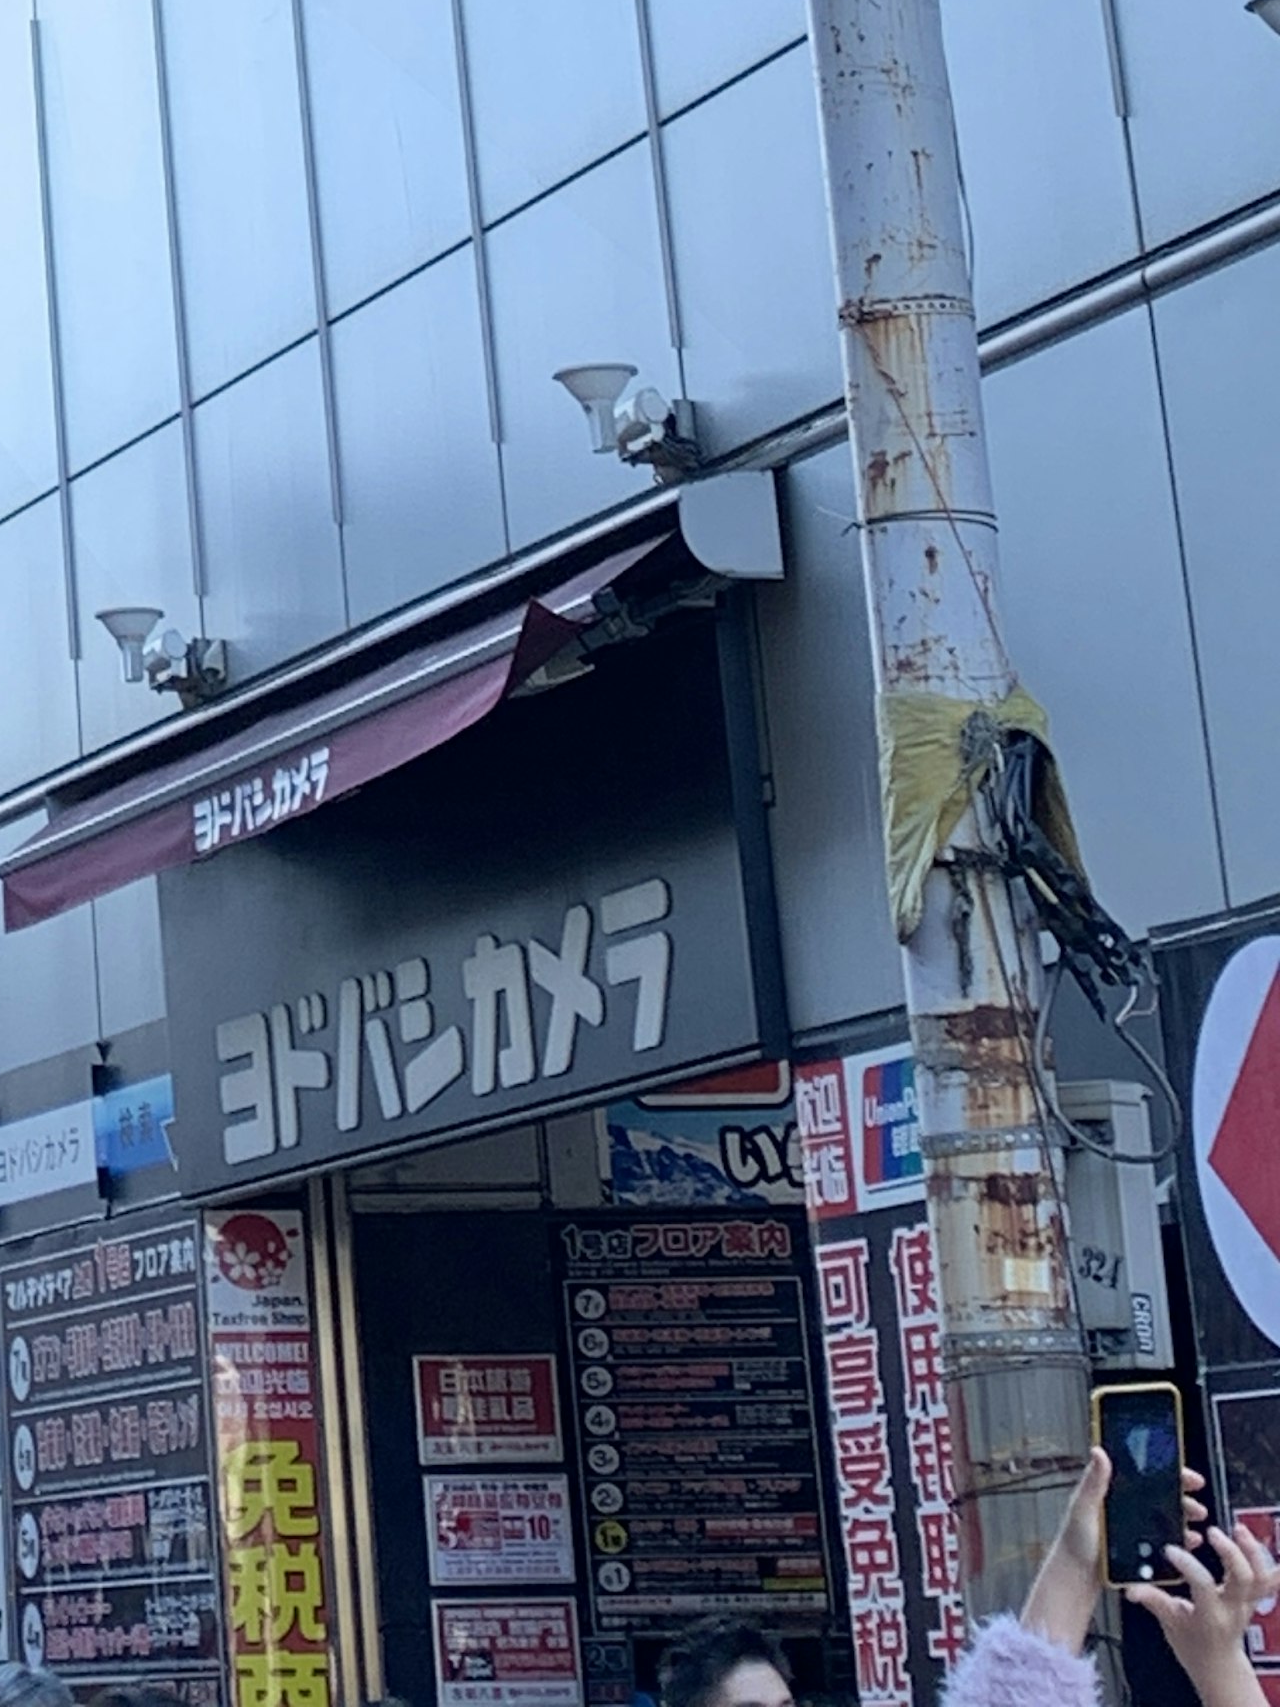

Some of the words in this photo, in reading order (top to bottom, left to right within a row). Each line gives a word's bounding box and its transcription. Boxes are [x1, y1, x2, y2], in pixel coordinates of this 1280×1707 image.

[193, 748, 330, 852] ヨドバシカメラ
[216, 877, 671, 1166] ヨドバシカメラ
[815, 1238, 915, 1707] 可享受免税
